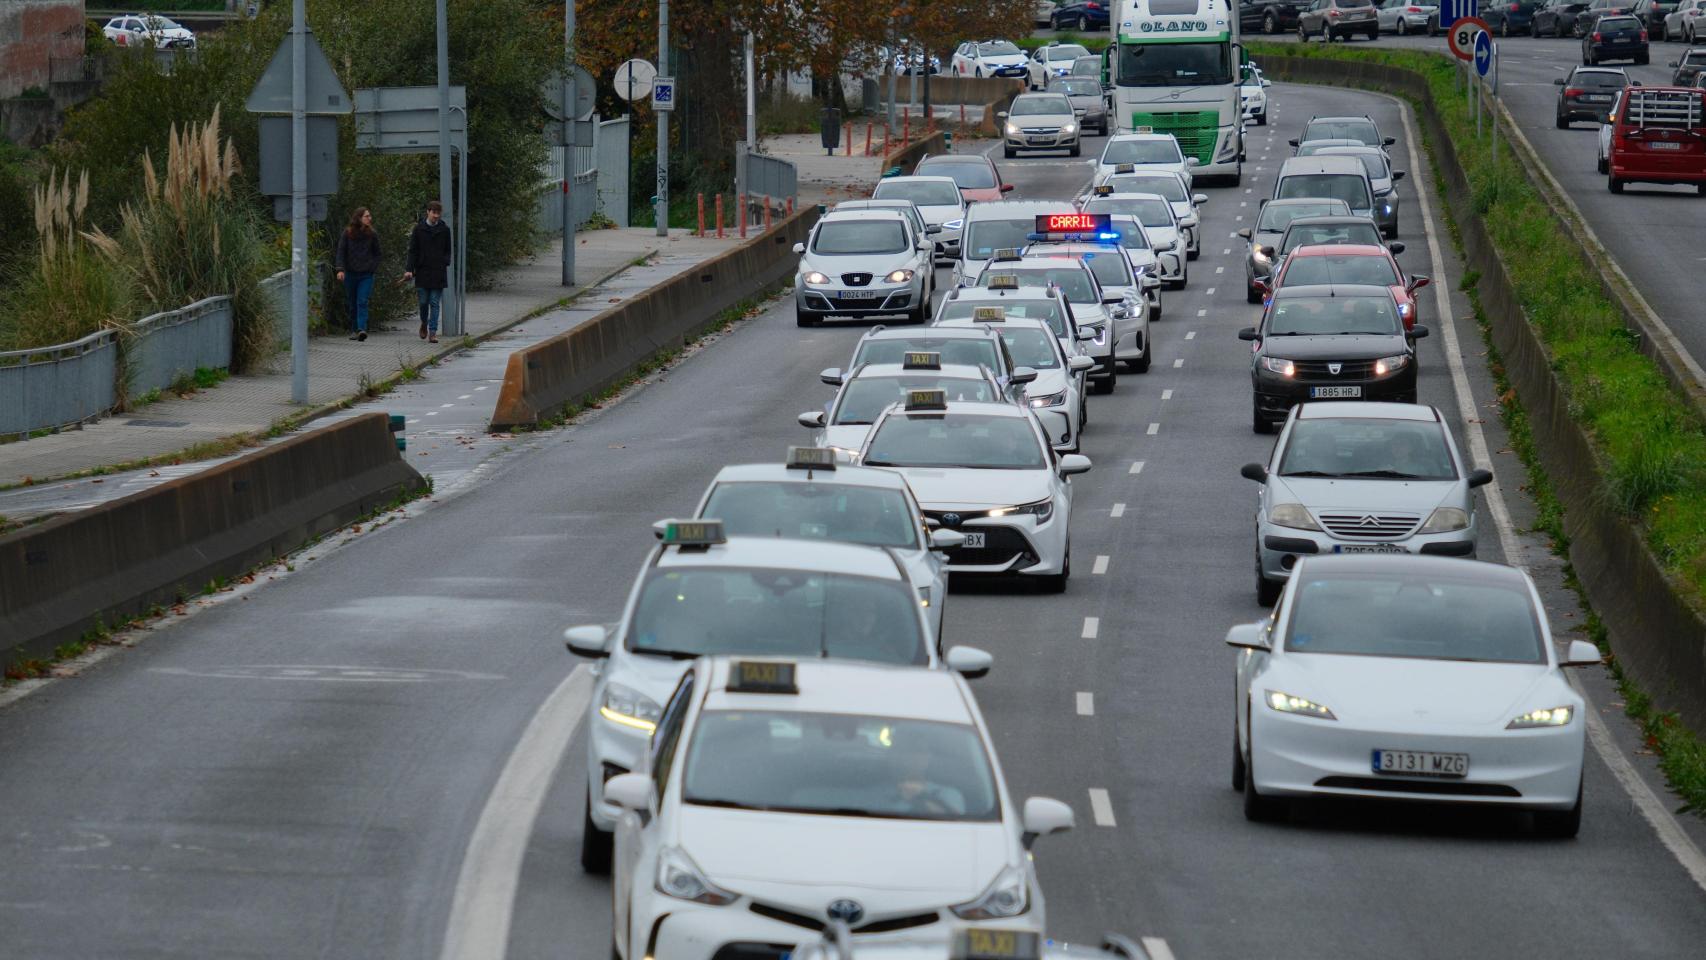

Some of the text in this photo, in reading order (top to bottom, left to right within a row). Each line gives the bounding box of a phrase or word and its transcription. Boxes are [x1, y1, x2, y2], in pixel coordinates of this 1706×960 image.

[1141, 21, 1207, 32] OLANO
[1050, 216, 1095, 228] CARRIL
[912, 354, 929, 365] TAXI
[913, 393, 934, 403] TAXI
[1317, 388, 1359, 397] 1885 HRJ
[679, 525, 704, 539] TAXI
[742, 665, 777, 682] TAXI
[1384, 753, 1464, 772] 3131 MZG
[970, 929, 1015, 954] TAXI
